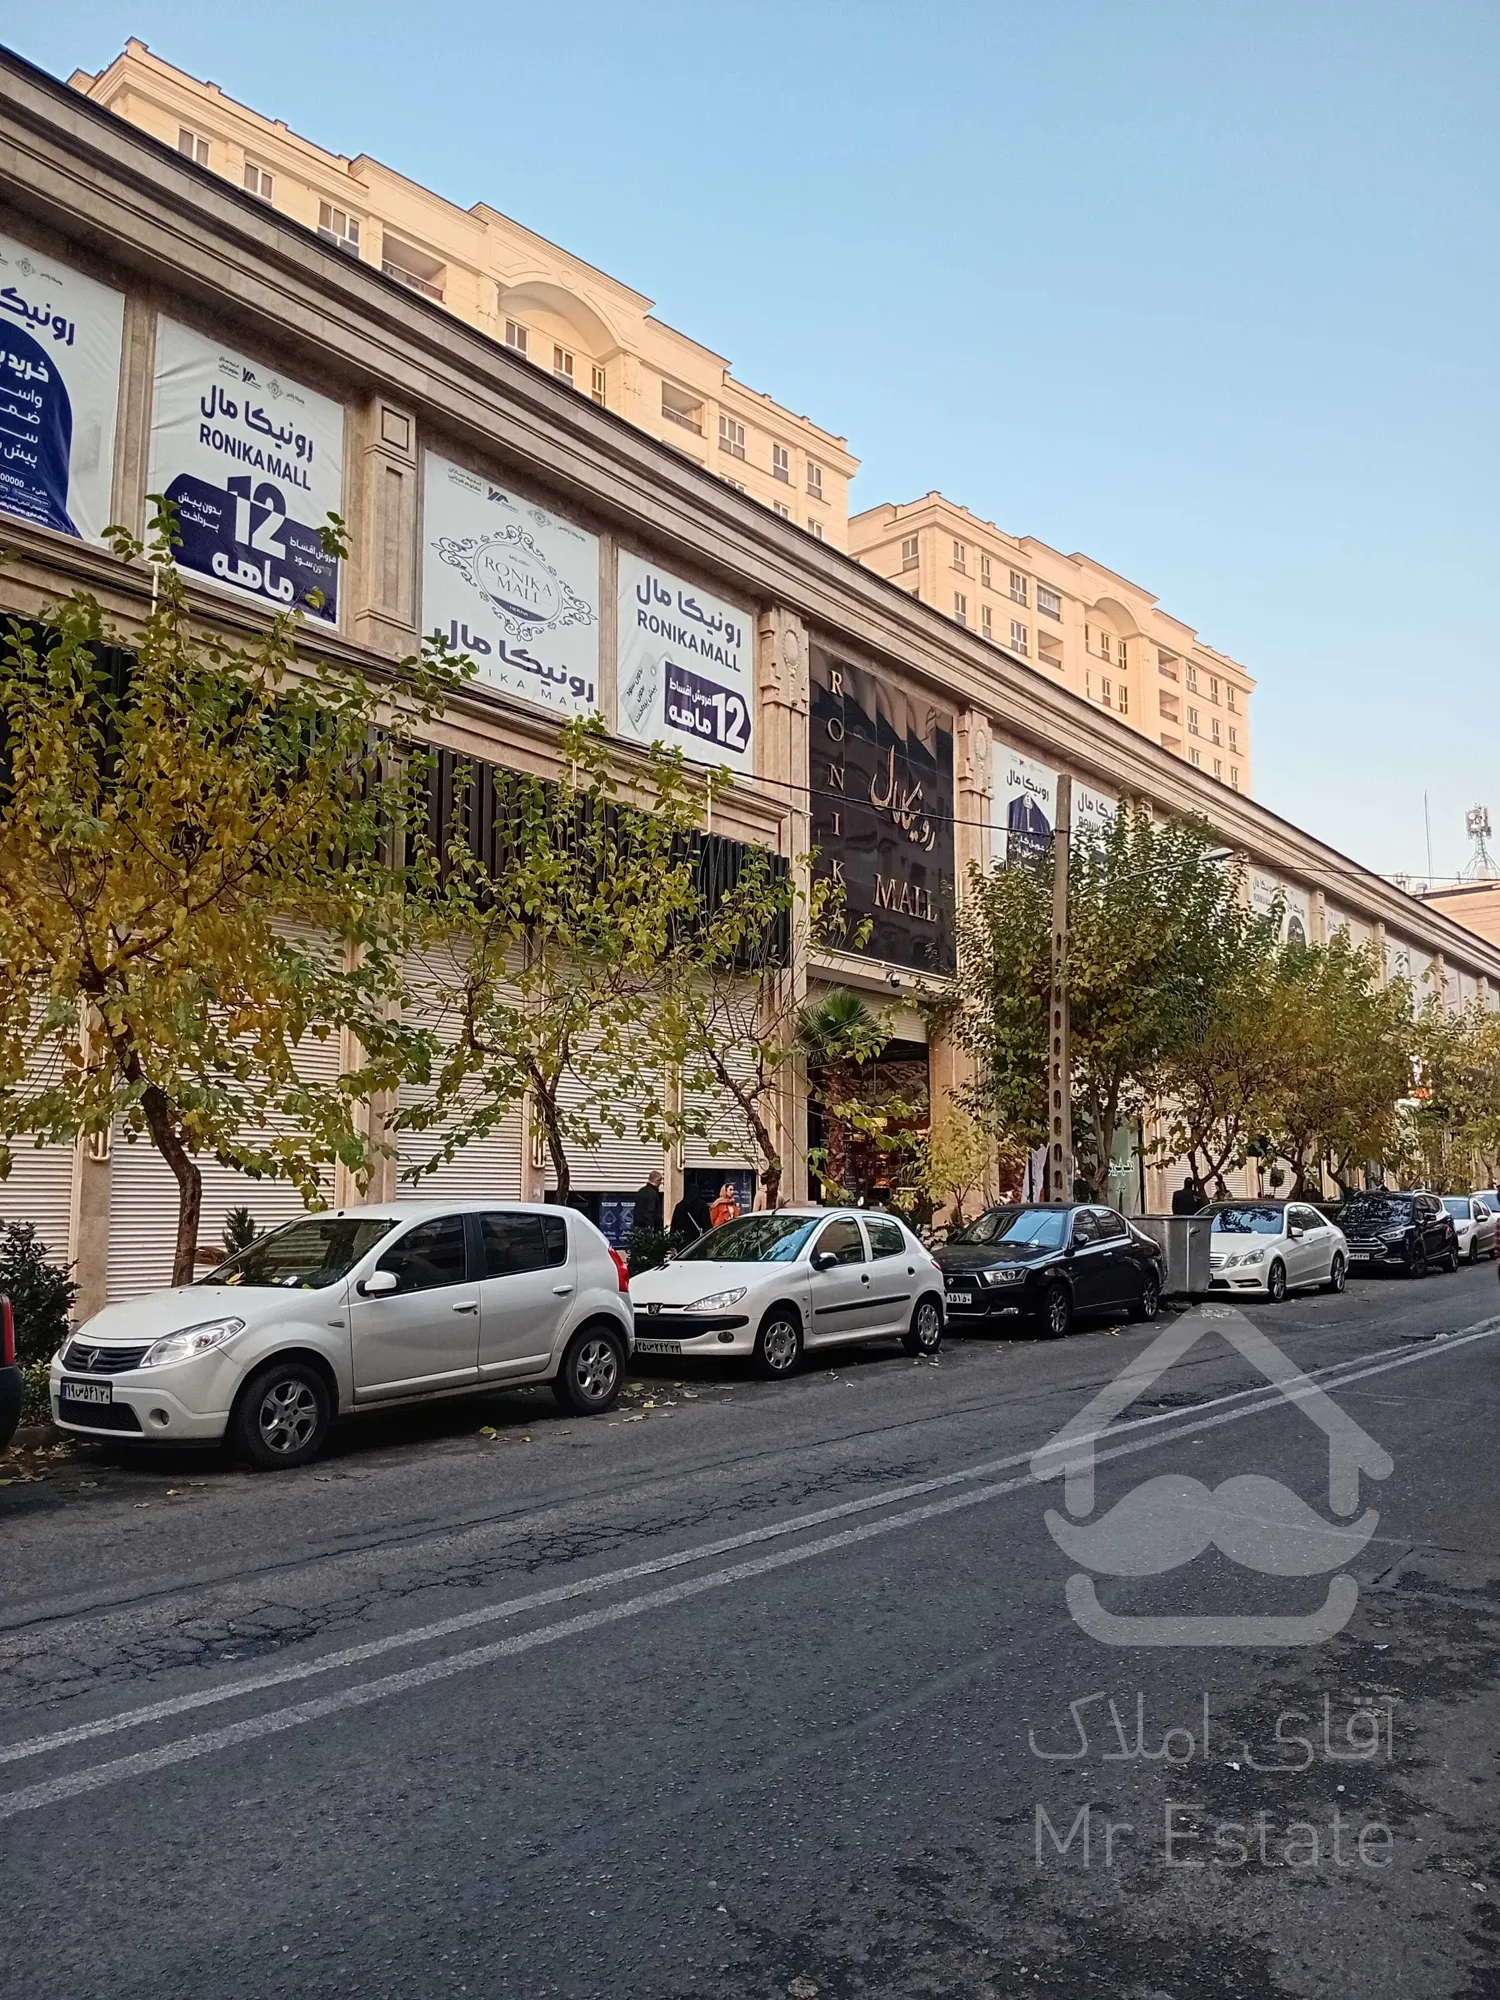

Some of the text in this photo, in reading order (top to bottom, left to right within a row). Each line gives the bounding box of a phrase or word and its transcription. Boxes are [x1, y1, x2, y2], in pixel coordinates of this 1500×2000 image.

[0, 287, 75, 346] رونیک
[8, 353, 49, 383] خرید
[0, 385, 43, 408] واس
[201, 385, 313, 463] رونیکا مال
[4, 444, 38, 469] پیش
[200, 423, 311, 491] RONIKA MALL
[178, 491, 222, 517] بدون پیش
[180, 509, 219, 534] پرداخت
[227, 475, 286, 560] 12
[212, 551, 294, 602] ماهه
[485, 556, 552, 597] RONIKA
[637, 575, 741, 648] رونیکا مال
[434, 620, 594, 703] رونیکا مال
[637, 609, 741, 673] RONIKA MALL
[668, 705, 711, 734] ماهه
[712, 693, 745, 750] 12
[826, 669, 846, 885] RONIK
[1006, 769, 1050, 801] رونیکا مال
[1077, 792, 1093, 812] مال
[873, 873, 938, 923] MALL
